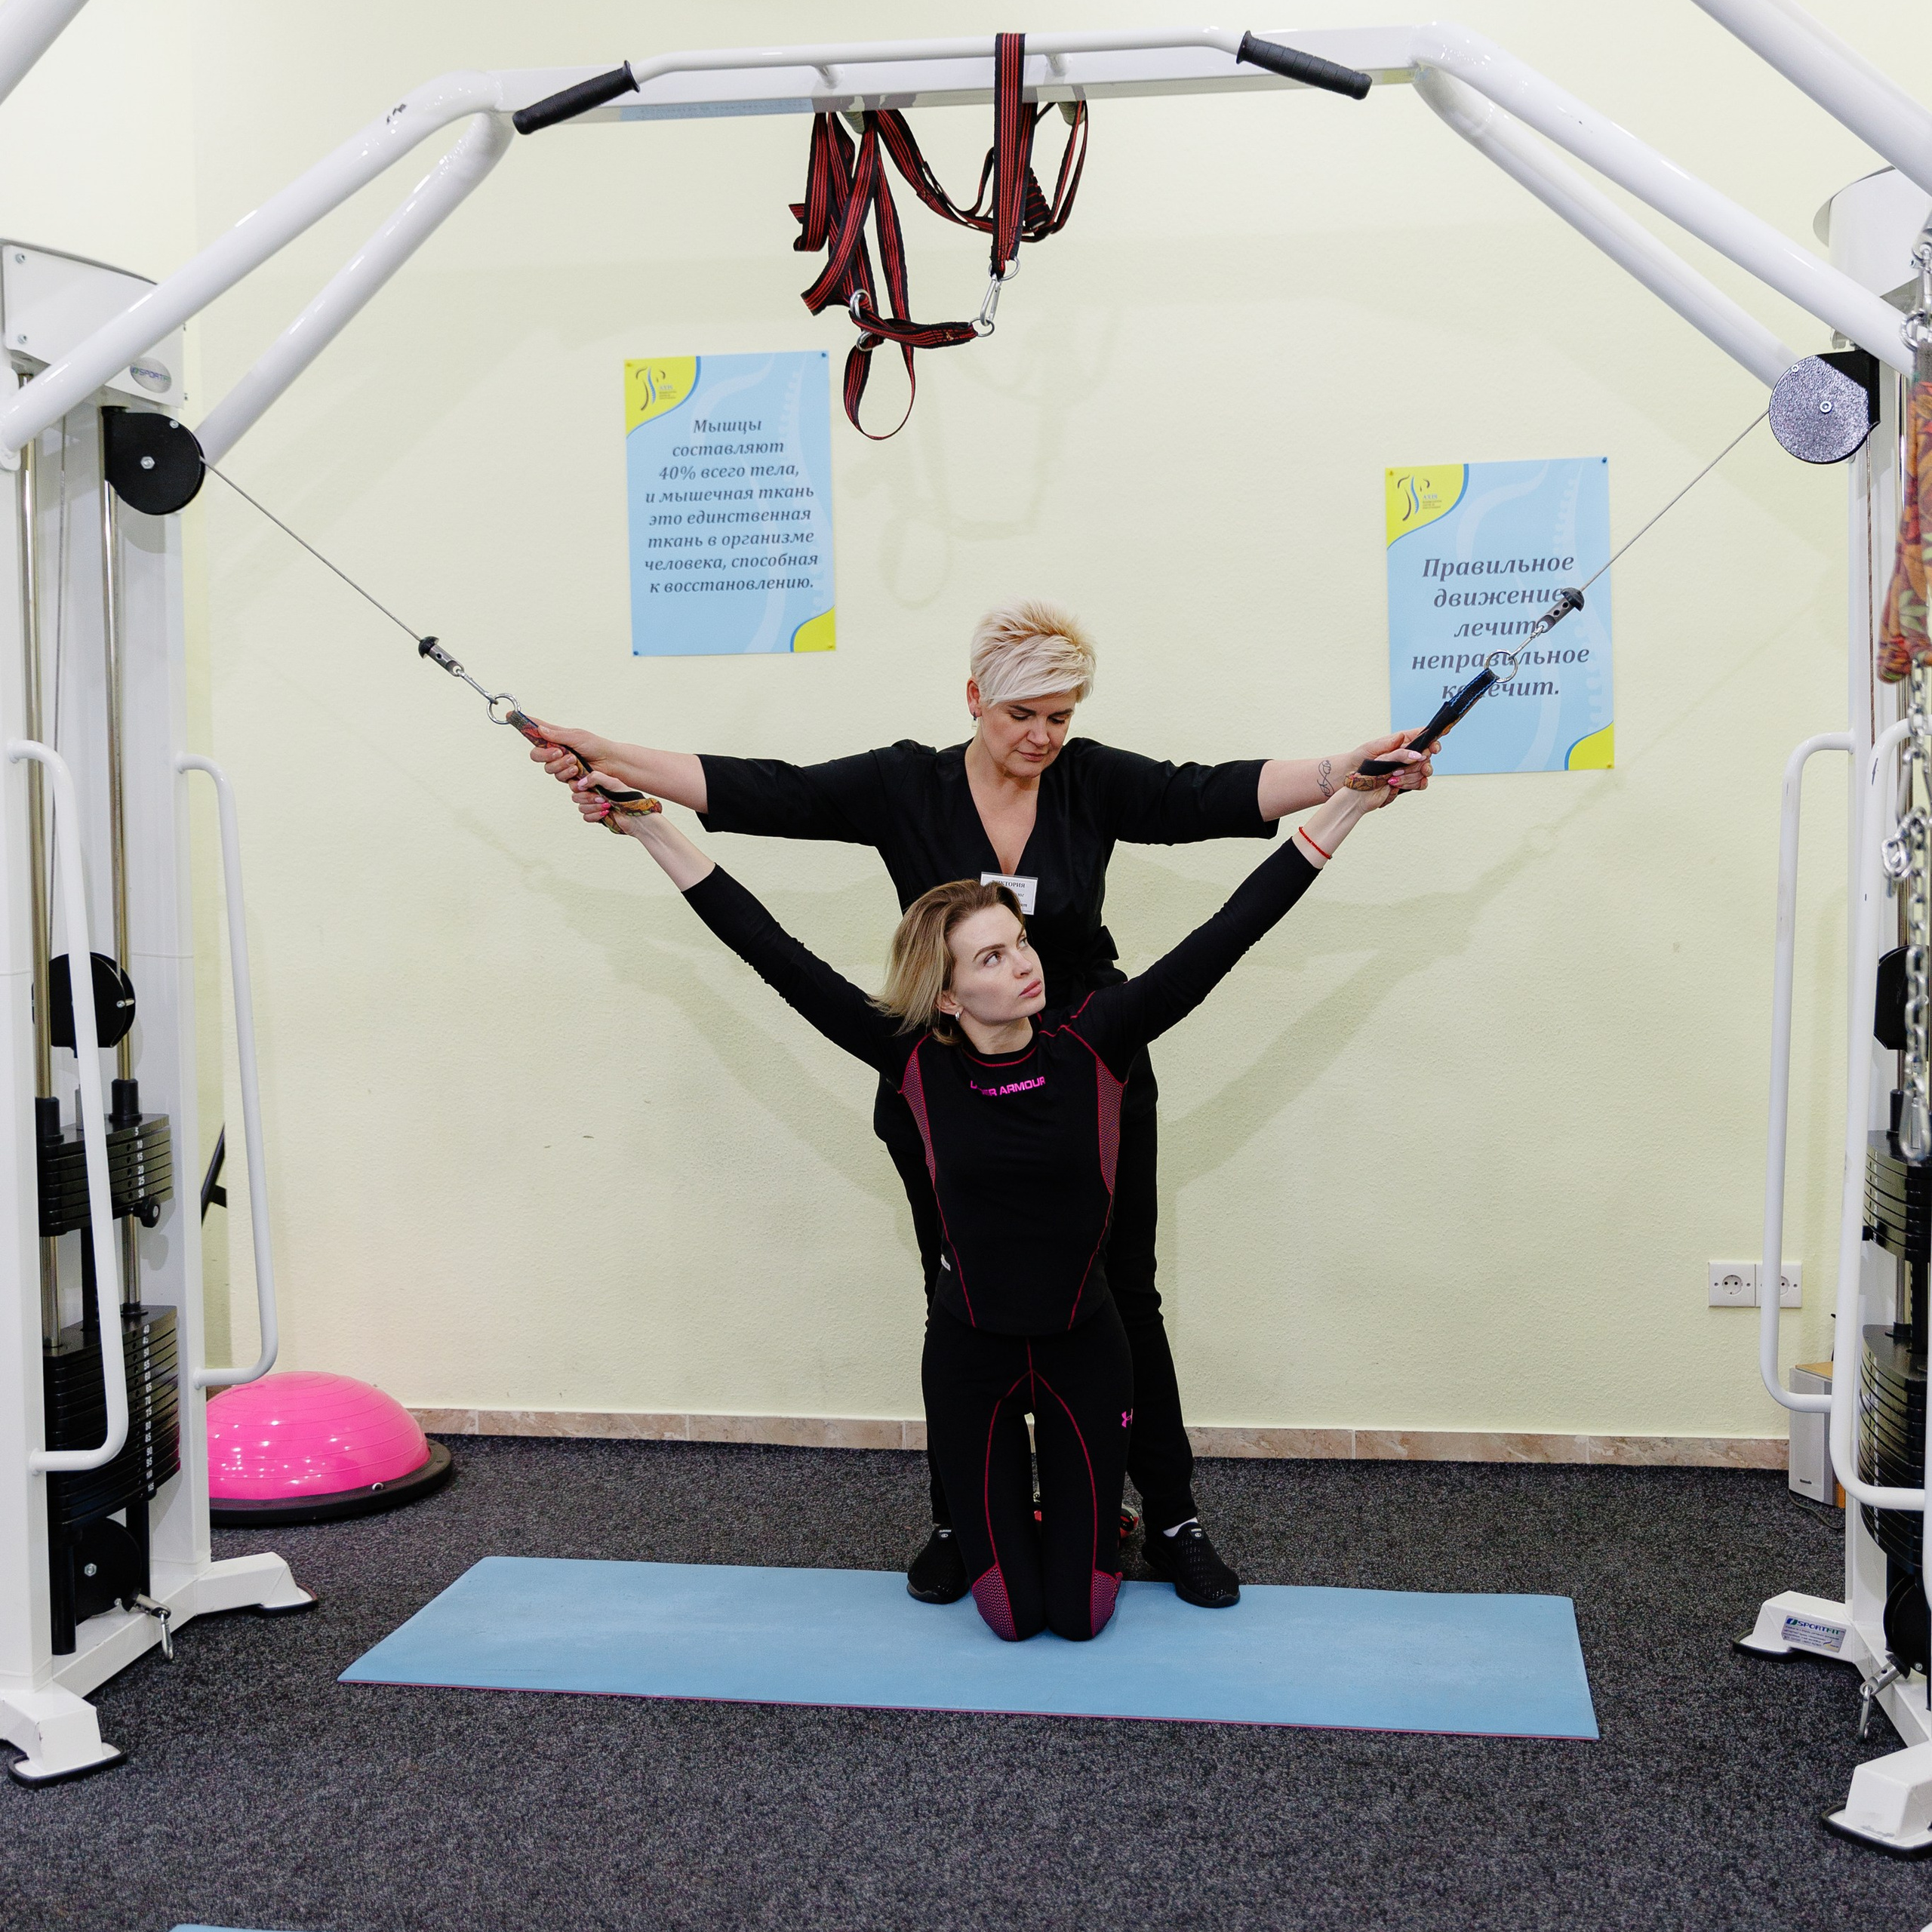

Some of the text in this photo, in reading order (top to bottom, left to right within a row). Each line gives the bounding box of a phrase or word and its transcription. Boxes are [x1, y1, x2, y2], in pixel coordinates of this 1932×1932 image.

[694, 420, 762, 435] Мышцы
[672, 443, 784, 457] составляют
[659, 466, 799, 480] 40% всего тела,
[645, 488, 814, 503] и мышечная ткань
[648, 509, 811, 526] это единственная
[648, 533, 814, 549] ткань в организме
[645, 553, 819, 571] человека, способная
[1422, 556, 1574, 583] Правильное
[650, 578, 814, 593] к восстановлению.
[1433, 588, 1563, 608] движение
[1411, 648, 1590, 673] неправильное
[1441, 681, 1560, 700] кечит.
[999, 1076, 1046, 1096] ARMOUR
[135, 1127, 139, 1137] 5
[137, 1152, 143, 1161] 15
[137, 1165, 144, 1175] 20
[138, 1176, 145, 1186] 25
[1797, 1620, 1841, 1635] SPORTFIT
